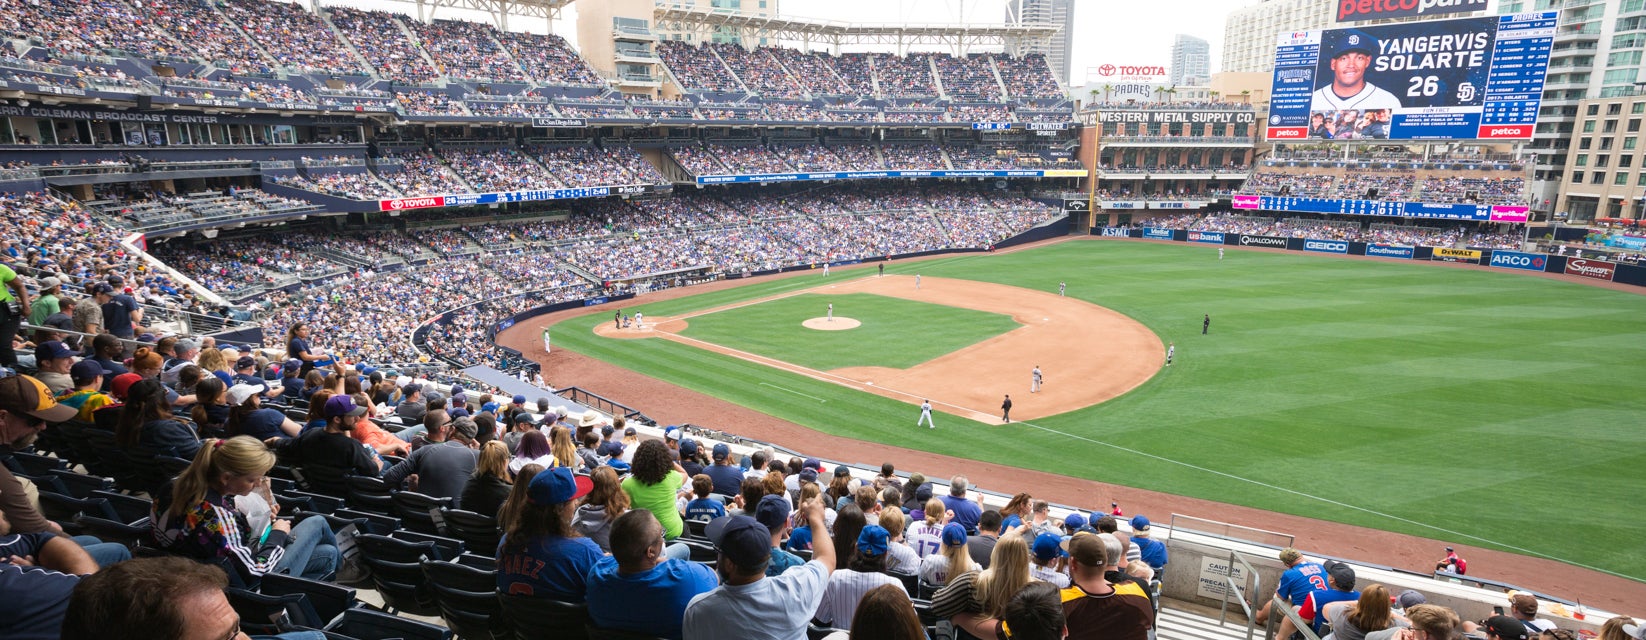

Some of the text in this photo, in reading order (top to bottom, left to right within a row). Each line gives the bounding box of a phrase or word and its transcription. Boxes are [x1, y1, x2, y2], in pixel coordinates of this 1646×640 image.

[1378, 32, 1488, 54] YANGERVIS
[1374, 50, 1484, 71] SOLARTE
[1120, 66, 1166, 76] TOYOTA
[1115, 84, 1150, 97] PADRES
[1407, 76, 1439, 96] 26
[31, 108, 91, 118] COLEMAN
[95, 112, 167, 122] BROADCAST
[172, 115, 218, 123] CENTER
[1100, 112, 1149, 122] WESTERN
[1154, 112, 1189, 122] METAL
[1192, 112, 1233, 122] SUPPLY
[1237, 113, 1254, 123] CO.
[1491, 128, 1520, 136] petco
[404, 199, 436, 207] TOYOTA
[1102, 228, 1129, 237] ASML
[1306, 242, 1347, 251] GEICO
[1369, 247, 1405, 255] Southwest
[1492, 255, 1530, 266] ARCO
[1571, 259, 1609, 275] Sycuan
[918, 540, 940, 558] 17
[1209, 563, 1240, 573] CAUTON
[1309, 576, 1328, 591] 3
